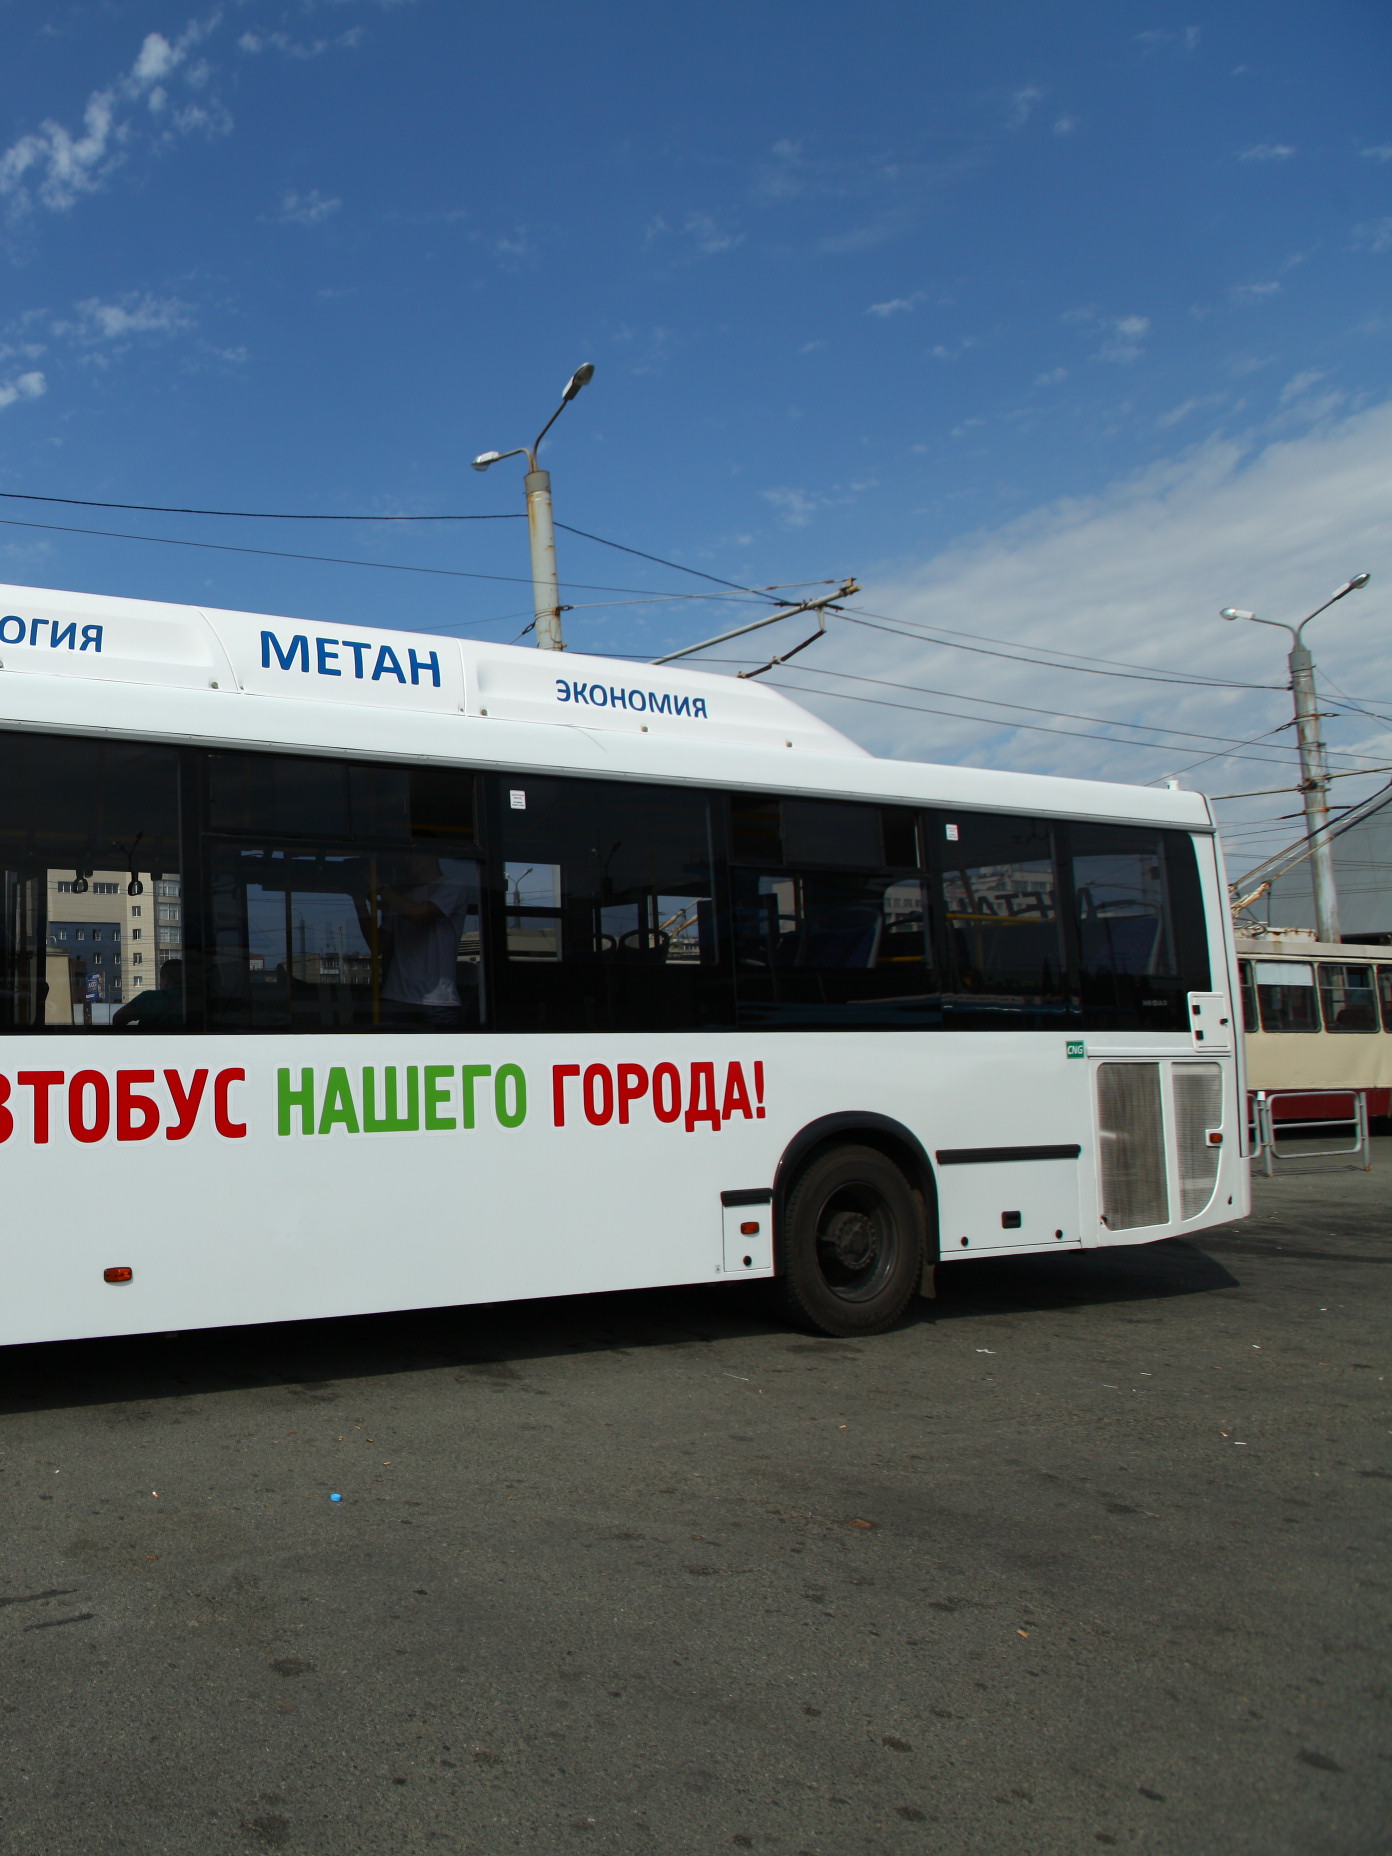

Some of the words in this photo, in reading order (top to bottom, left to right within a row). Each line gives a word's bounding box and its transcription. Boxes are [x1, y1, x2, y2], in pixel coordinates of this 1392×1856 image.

[260, 630, 441, 688] МЕТАН
[555, 679, 708, 719] ЭКОНОМИЯ
[1067, 1044, 1084, 1055] CNG
[277, 1063, 527, 1137] НАШЕГО
[552, 1060, 766, 1133] ГОРОДА!
